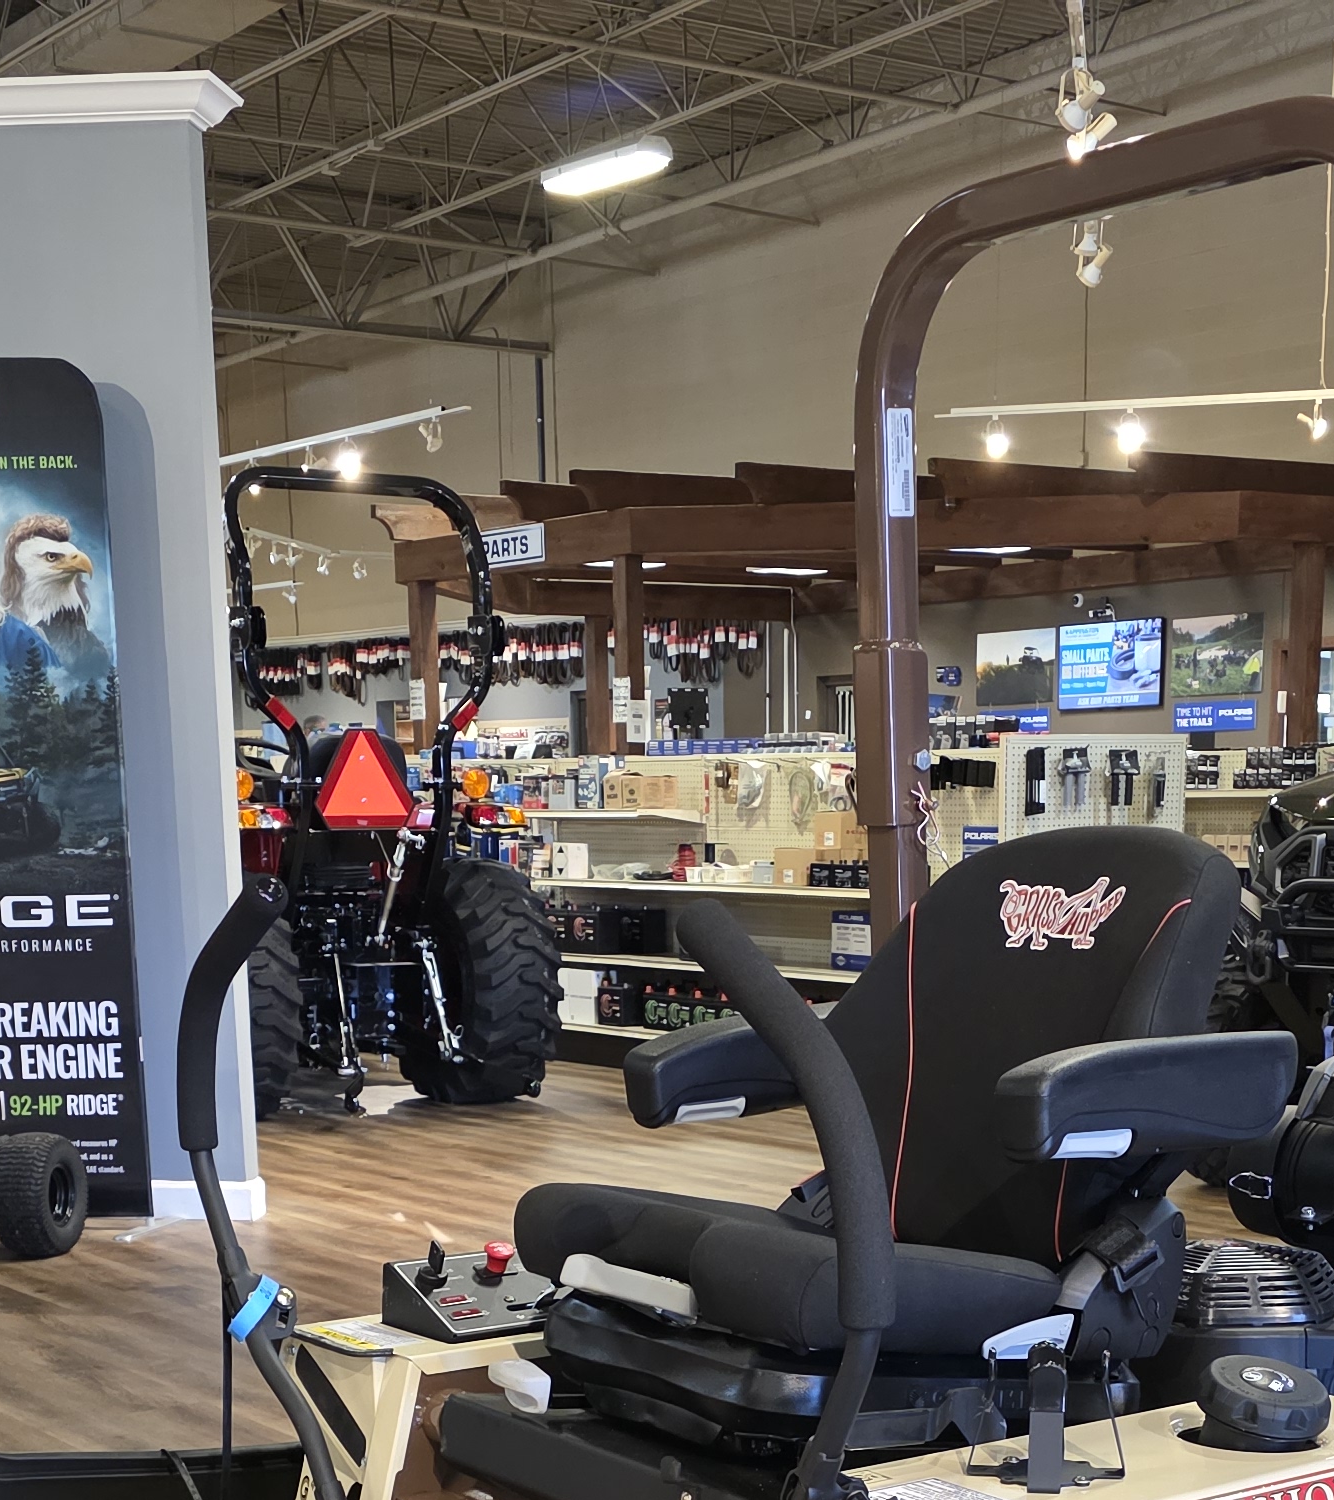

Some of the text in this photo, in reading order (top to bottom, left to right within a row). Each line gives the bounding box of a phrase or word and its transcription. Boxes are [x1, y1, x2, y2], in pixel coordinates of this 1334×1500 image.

[11, 456, 35, 469] THE
[39, 455, 78, 469] BACK.
[483, 535, 529, 558] PARTS
[1061, 649, 1085, 664] SMALL
[1103, 696, 1122, 704] PARTS
[1176, 706, 1213, 717] TIME TO HIT
[1218, 708, 1253, 716] POLARIS
[1176, 717, 1213, 727] THE TRAILS
[21, 1042, 124, 1080] ENGINE
[10, 1095, 63, 1116] 92-HP
[67, 1094, 118, 1116] RIDGE
